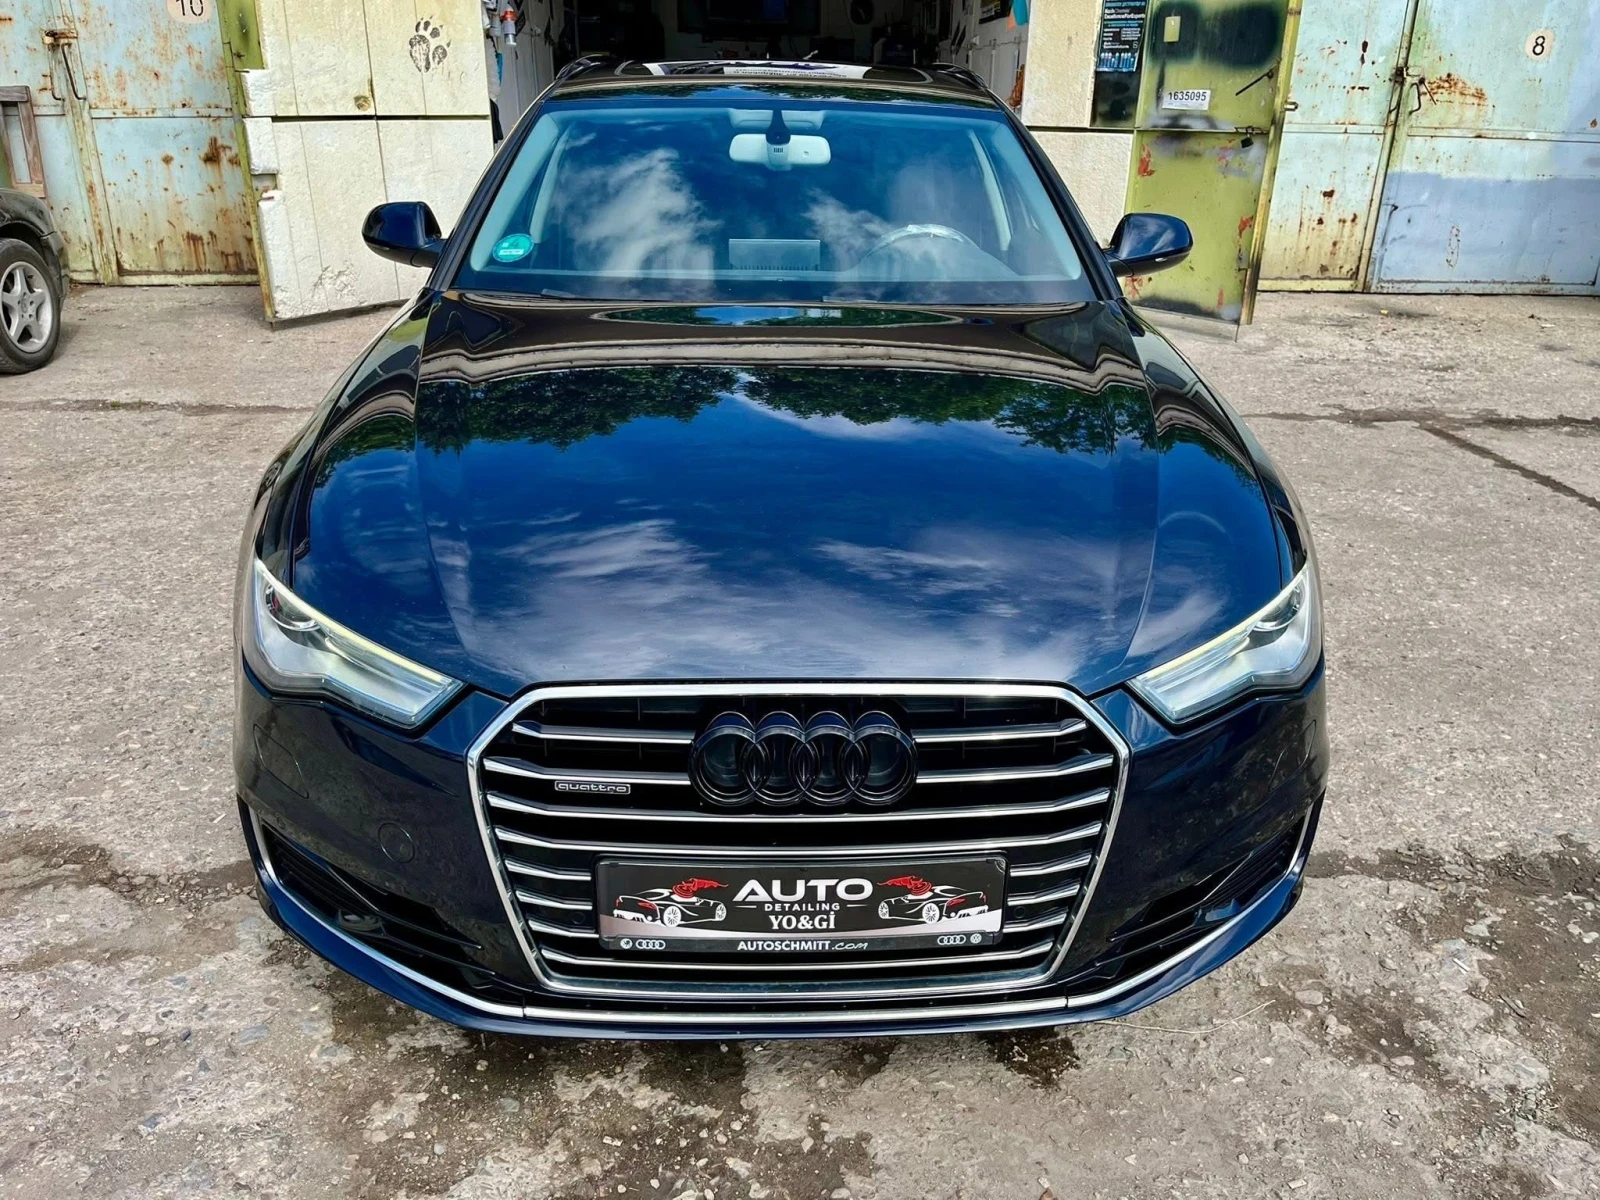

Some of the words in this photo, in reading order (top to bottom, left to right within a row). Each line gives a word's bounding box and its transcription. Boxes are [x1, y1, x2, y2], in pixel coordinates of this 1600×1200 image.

[1532, 35, 1546, 56] 8
[1168, 91, 1207, 101] 1635095
[557, 782, 627, 793] quattro
[732, 877, 874, 902] AUTO
[764, 903, 841, 912] DETAILING
